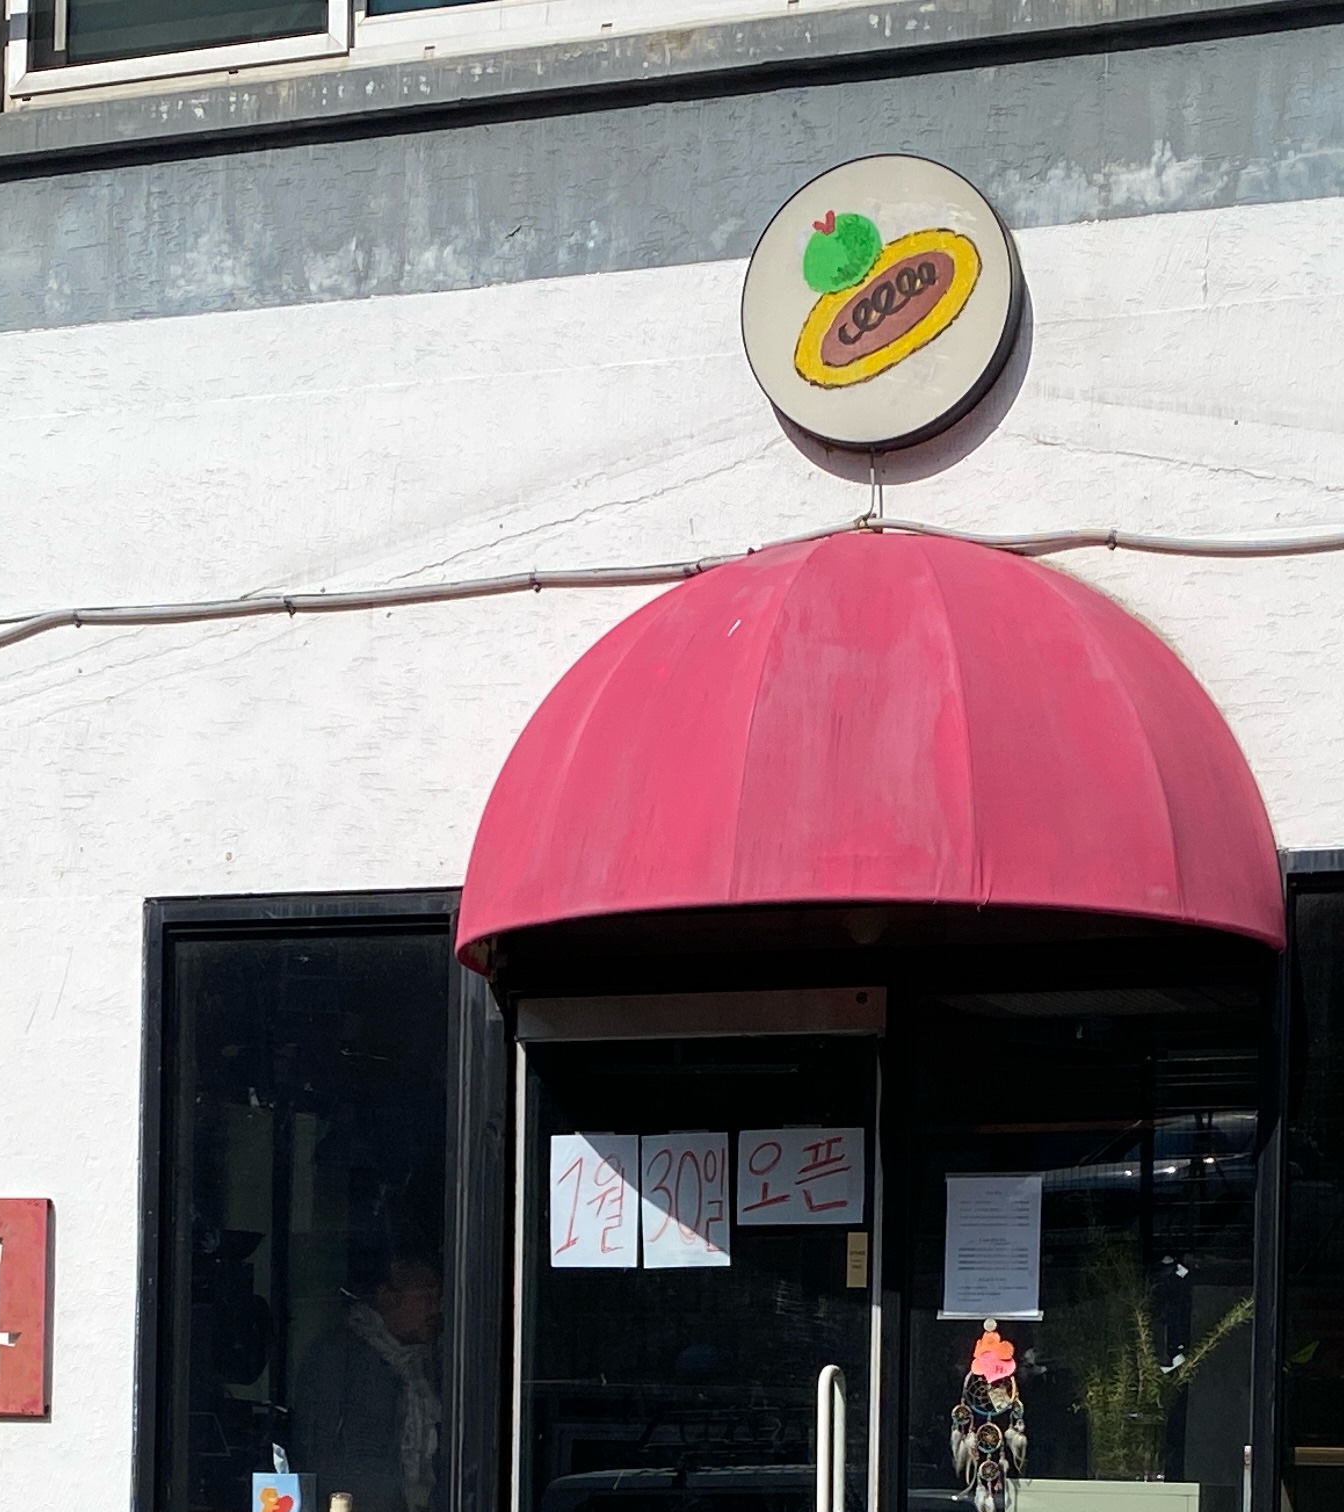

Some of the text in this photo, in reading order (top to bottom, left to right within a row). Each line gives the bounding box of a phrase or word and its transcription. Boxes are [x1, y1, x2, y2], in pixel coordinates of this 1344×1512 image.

[554, 1136, 853, 1256] 1월 30일 오픈
